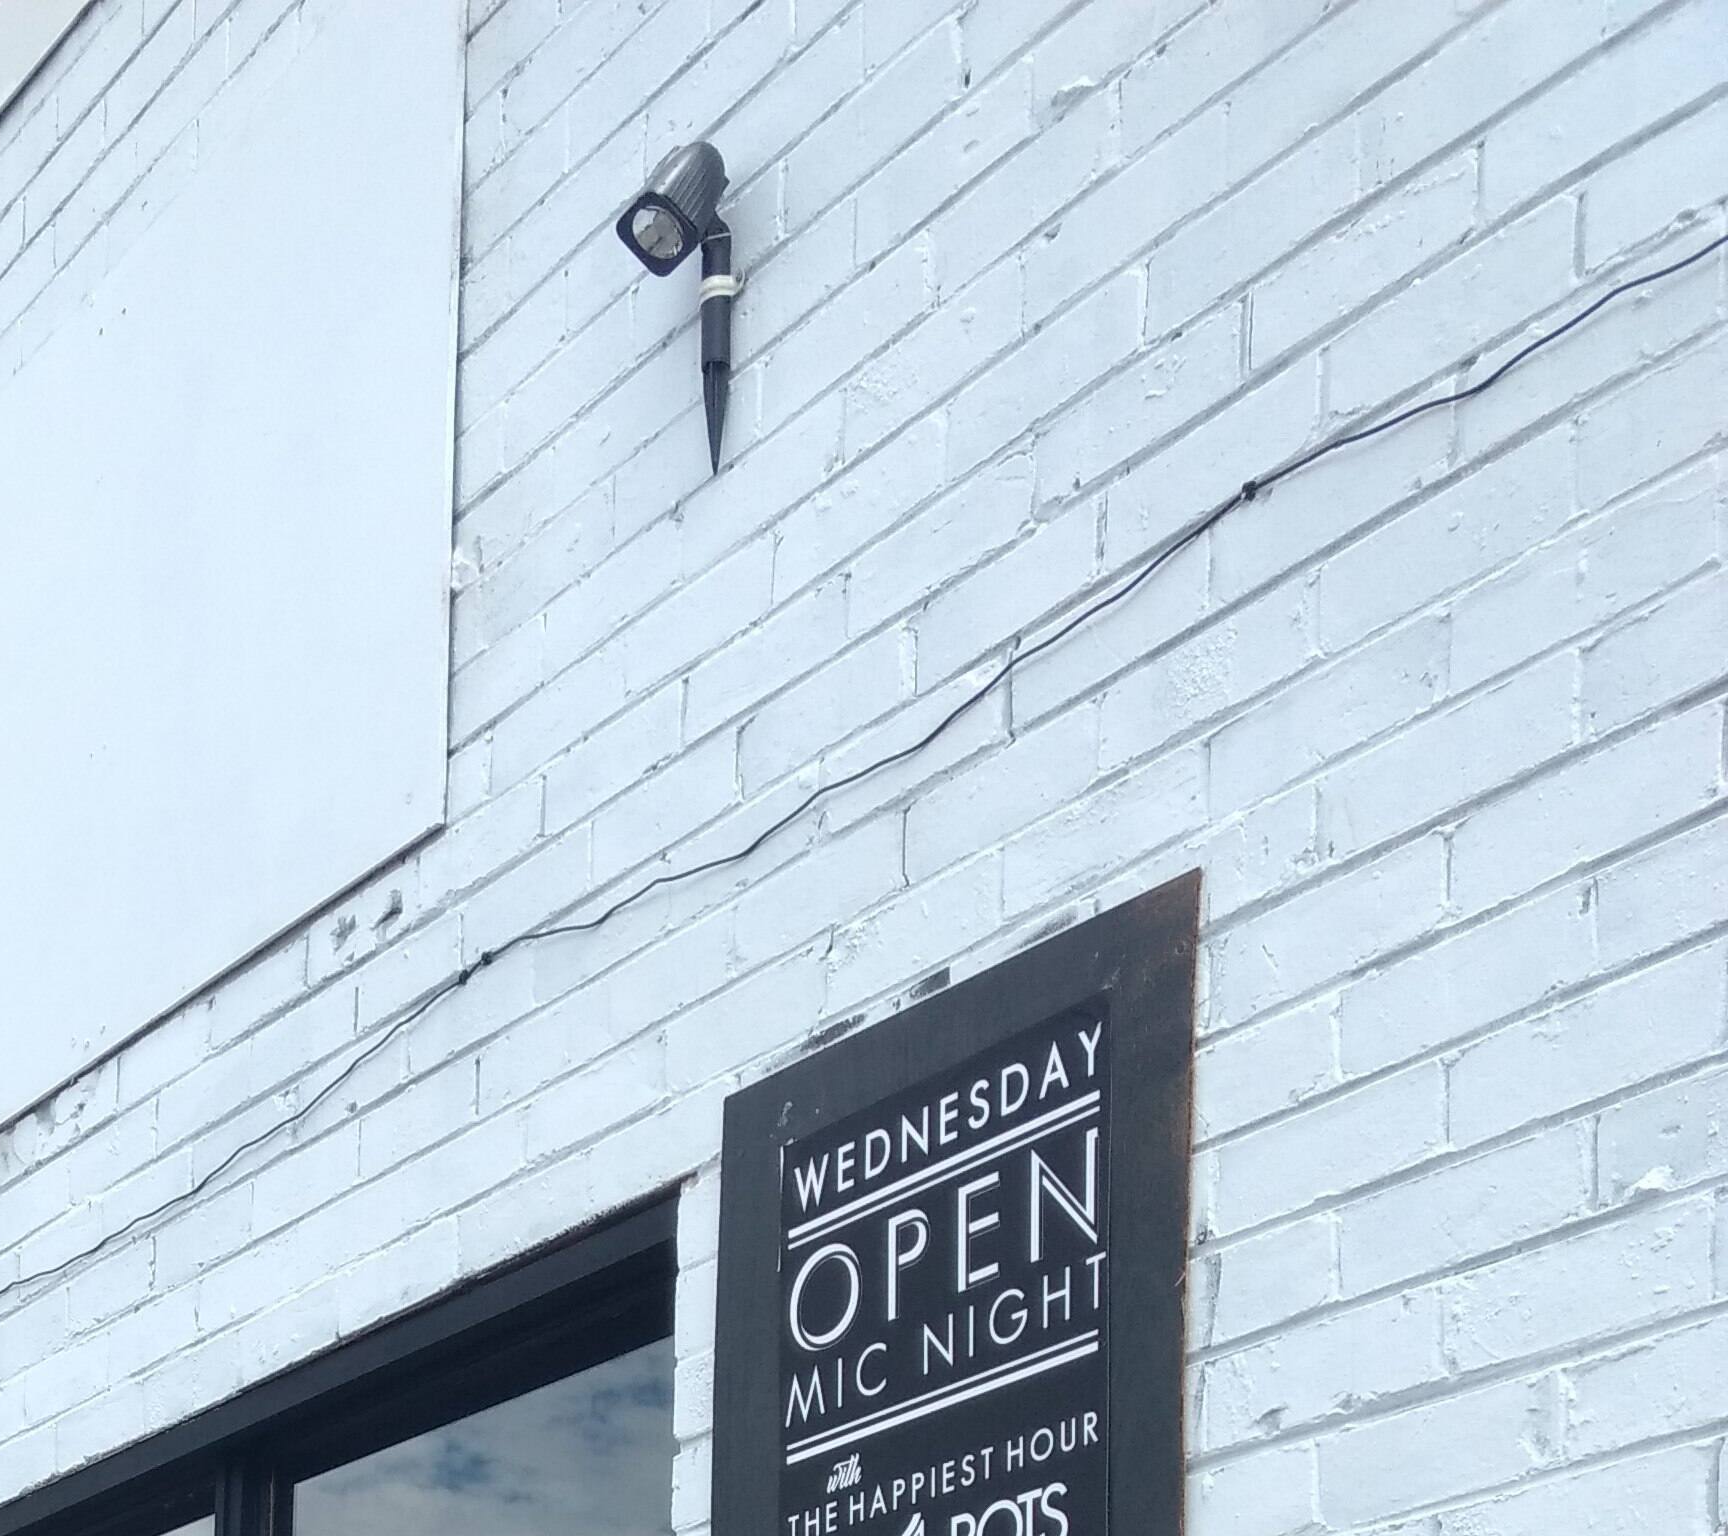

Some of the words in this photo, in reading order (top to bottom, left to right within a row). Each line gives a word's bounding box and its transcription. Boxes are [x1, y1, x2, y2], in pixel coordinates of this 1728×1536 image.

[794, 1022, 1102, 1213] WEDNESDAY
[789, 1126, 1100, 1351] OPEN
[786, 1342, 887, 1427] MIC
[923, 1252, 1106, 1368] NIGHT
[826, 1453, 863, 1494] with
[847, 1448, 994, 1526] HAPPIEST
[1005, 1411, 1099, 1470] HOUR
